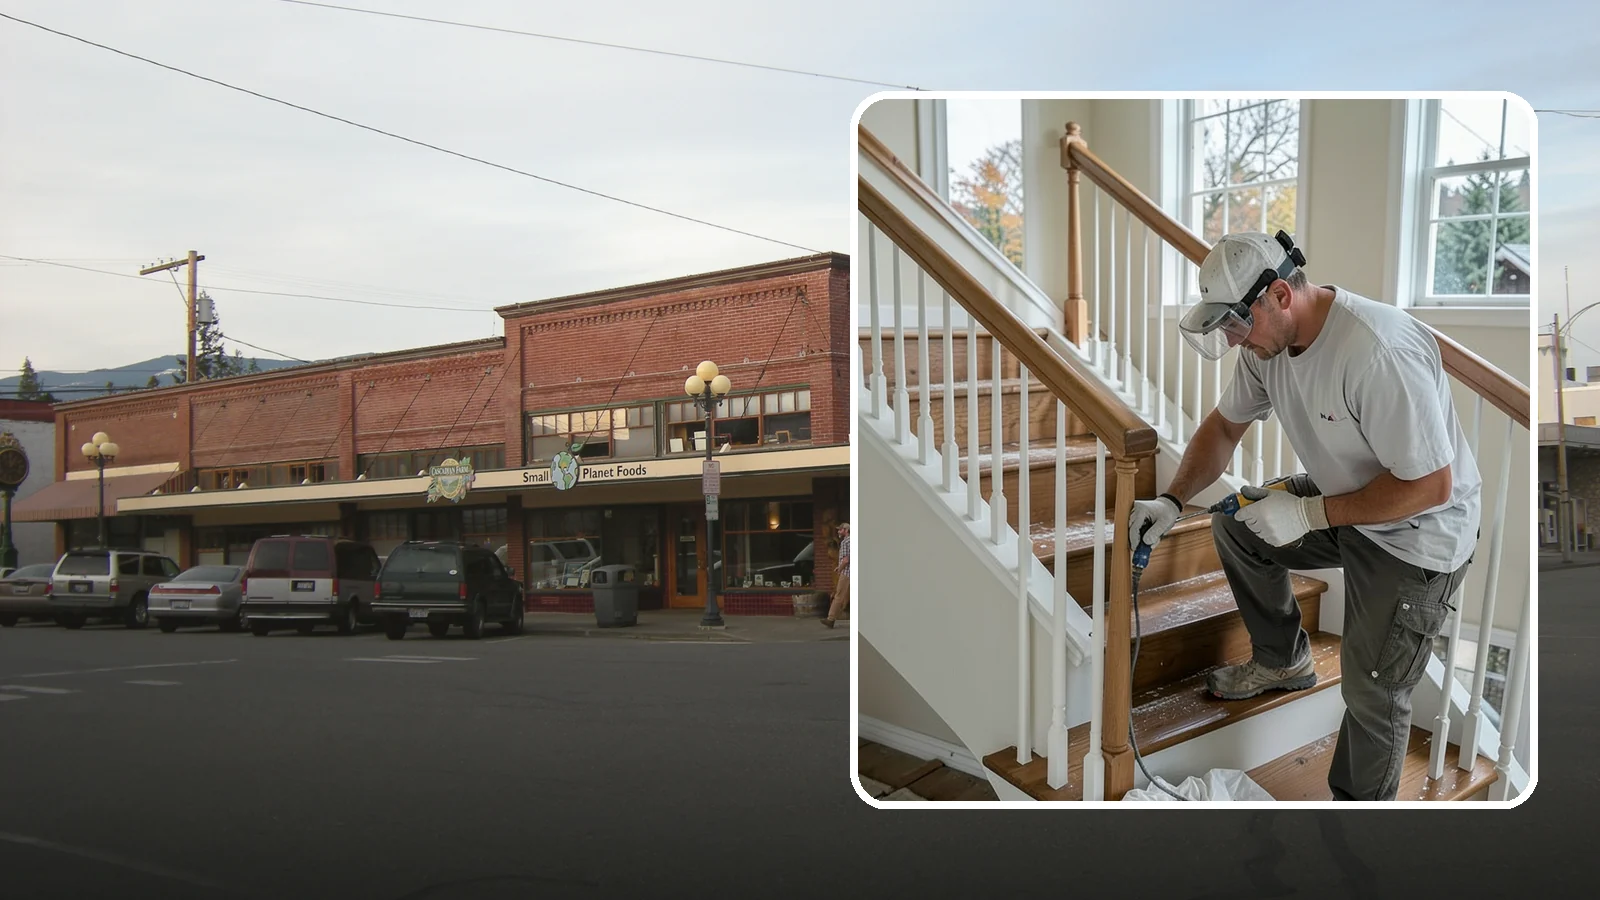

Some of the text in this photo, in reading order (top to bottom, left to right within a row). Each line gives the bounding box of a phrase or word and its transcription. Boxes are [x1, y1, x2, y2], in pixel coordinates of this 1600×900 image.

[523, 464, 647, 483] Small Planet Foods
